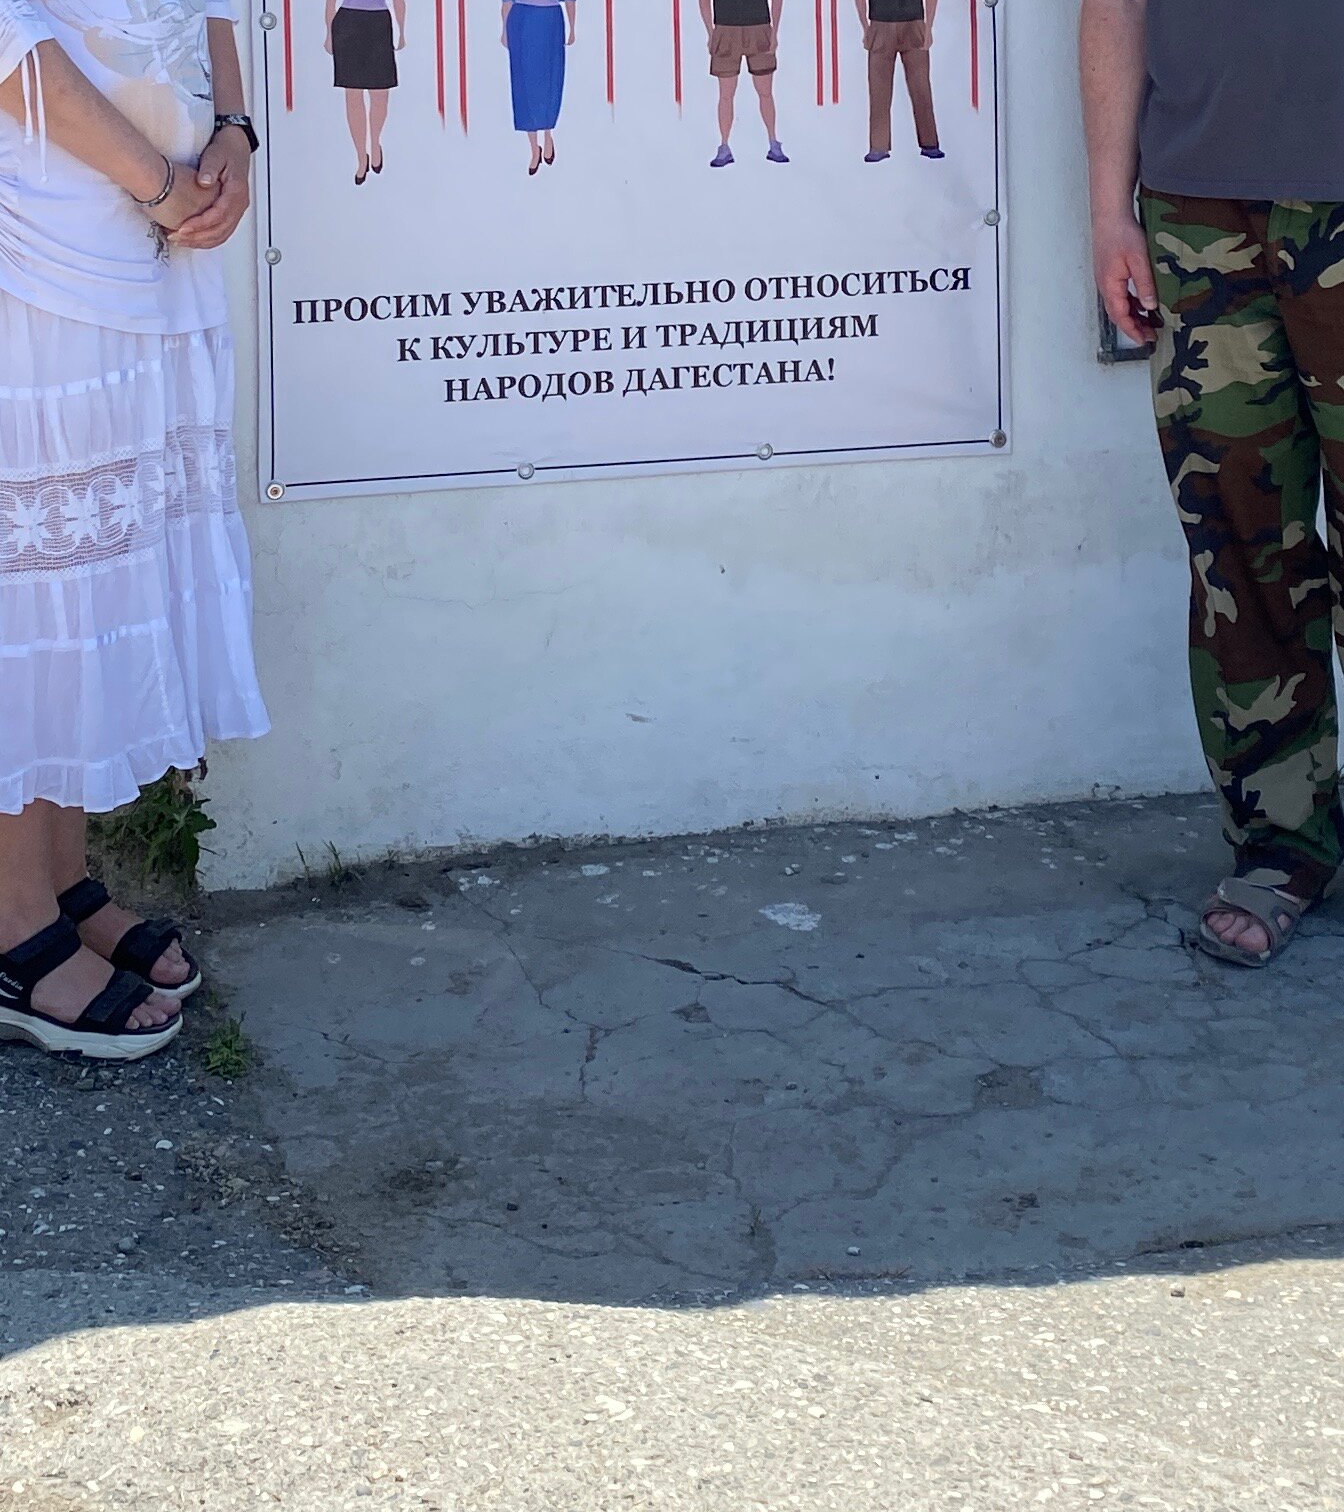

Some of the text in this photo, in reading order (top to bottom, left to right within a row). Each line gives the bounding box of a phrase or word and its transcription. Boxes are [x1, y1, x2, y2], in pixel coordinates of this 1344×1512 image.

[292, 267, 972, 325] ПРОСИМ УВАЖИТЕЛЬНО ОТНОСИТЬСЯ
[396, 313, 880, 362] К КУЛЬТУРЕ И ТРАДИЦИЯМ
[443, 357, 836, 403] НАРОДОВ ДАГЕСТАНА!
